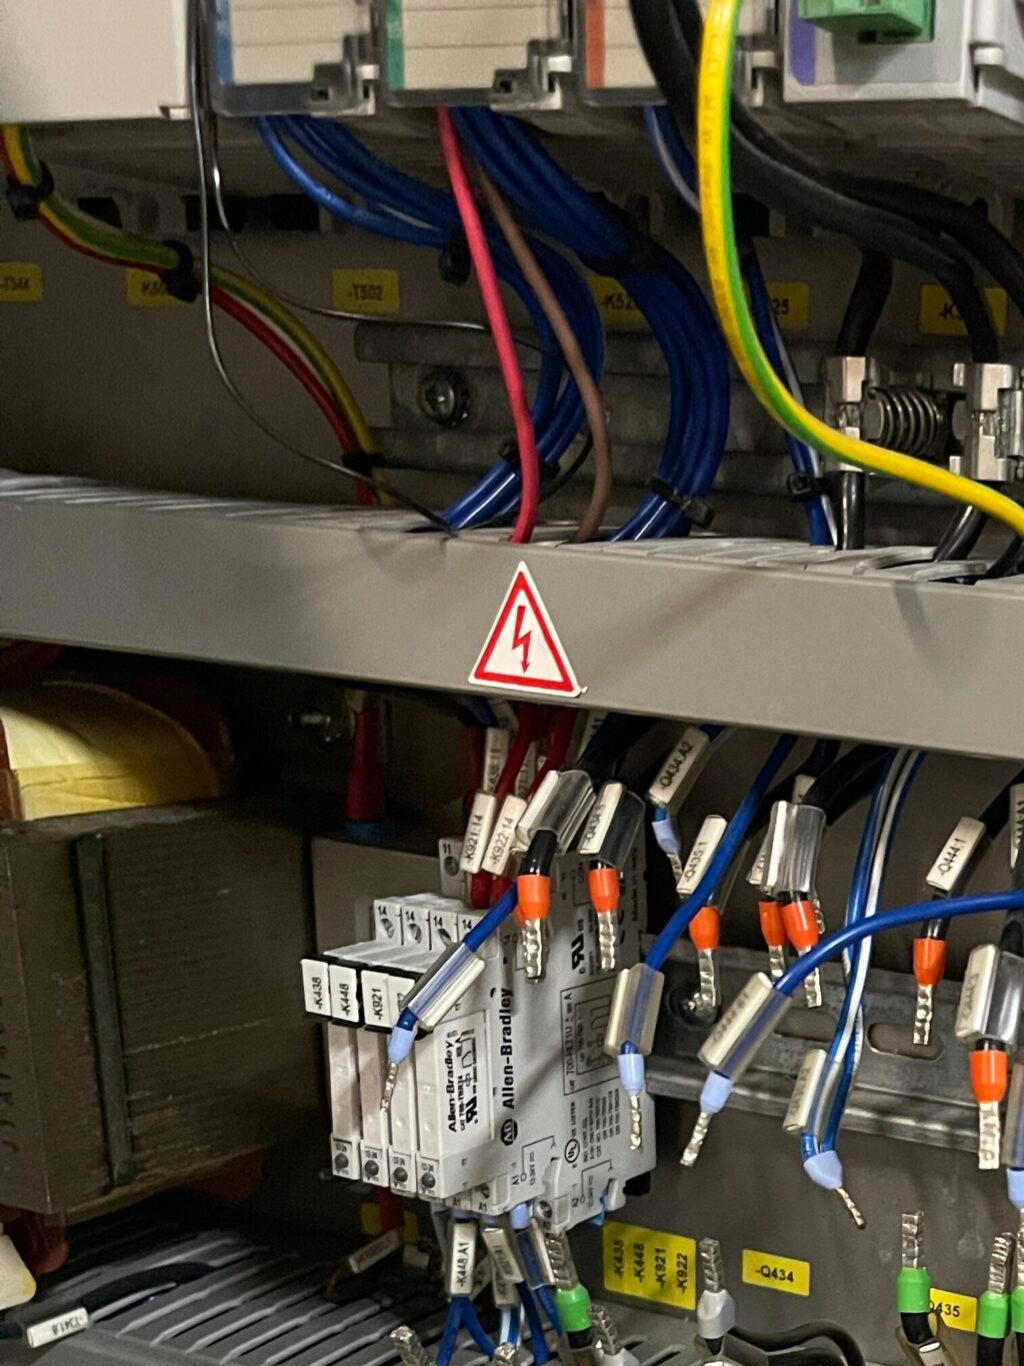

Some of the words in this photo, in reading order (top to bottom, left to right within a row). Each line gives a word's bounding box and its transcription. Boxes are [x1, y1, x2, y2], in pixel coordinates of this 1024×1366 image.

[442, 843, 451, 855] 11
[465, 814, 484, 865] -K921:14
[491, 816, 515, 866] -K922:14
[940, 837, 967, 876] -Q444:1
[378, 905, 387, 917] 14
[405, 910, 415, 922] 14
[433, 915, 443, 928] 14
[462, 918, 472, 931] 14
[311, 977, 323, 1010] -K438
[340, 983, 351, 1017] -K448
[372, 987, 384, 1020] -K921
[500, 987, 515, 1109] Allen-Bradley
[445, 1039, 457, 1133] Allen-Bradley
[456, 1241, 470, 1287] -K448:A1
[634, 1242, 645, 1284] -K448
[655, 1248, 666, 1290] -K921
[677, 1252, 688, 1294] -K922
[755, 1264, 795, 1284] -Q434
[929, 1299, 961, 1319] Q435
